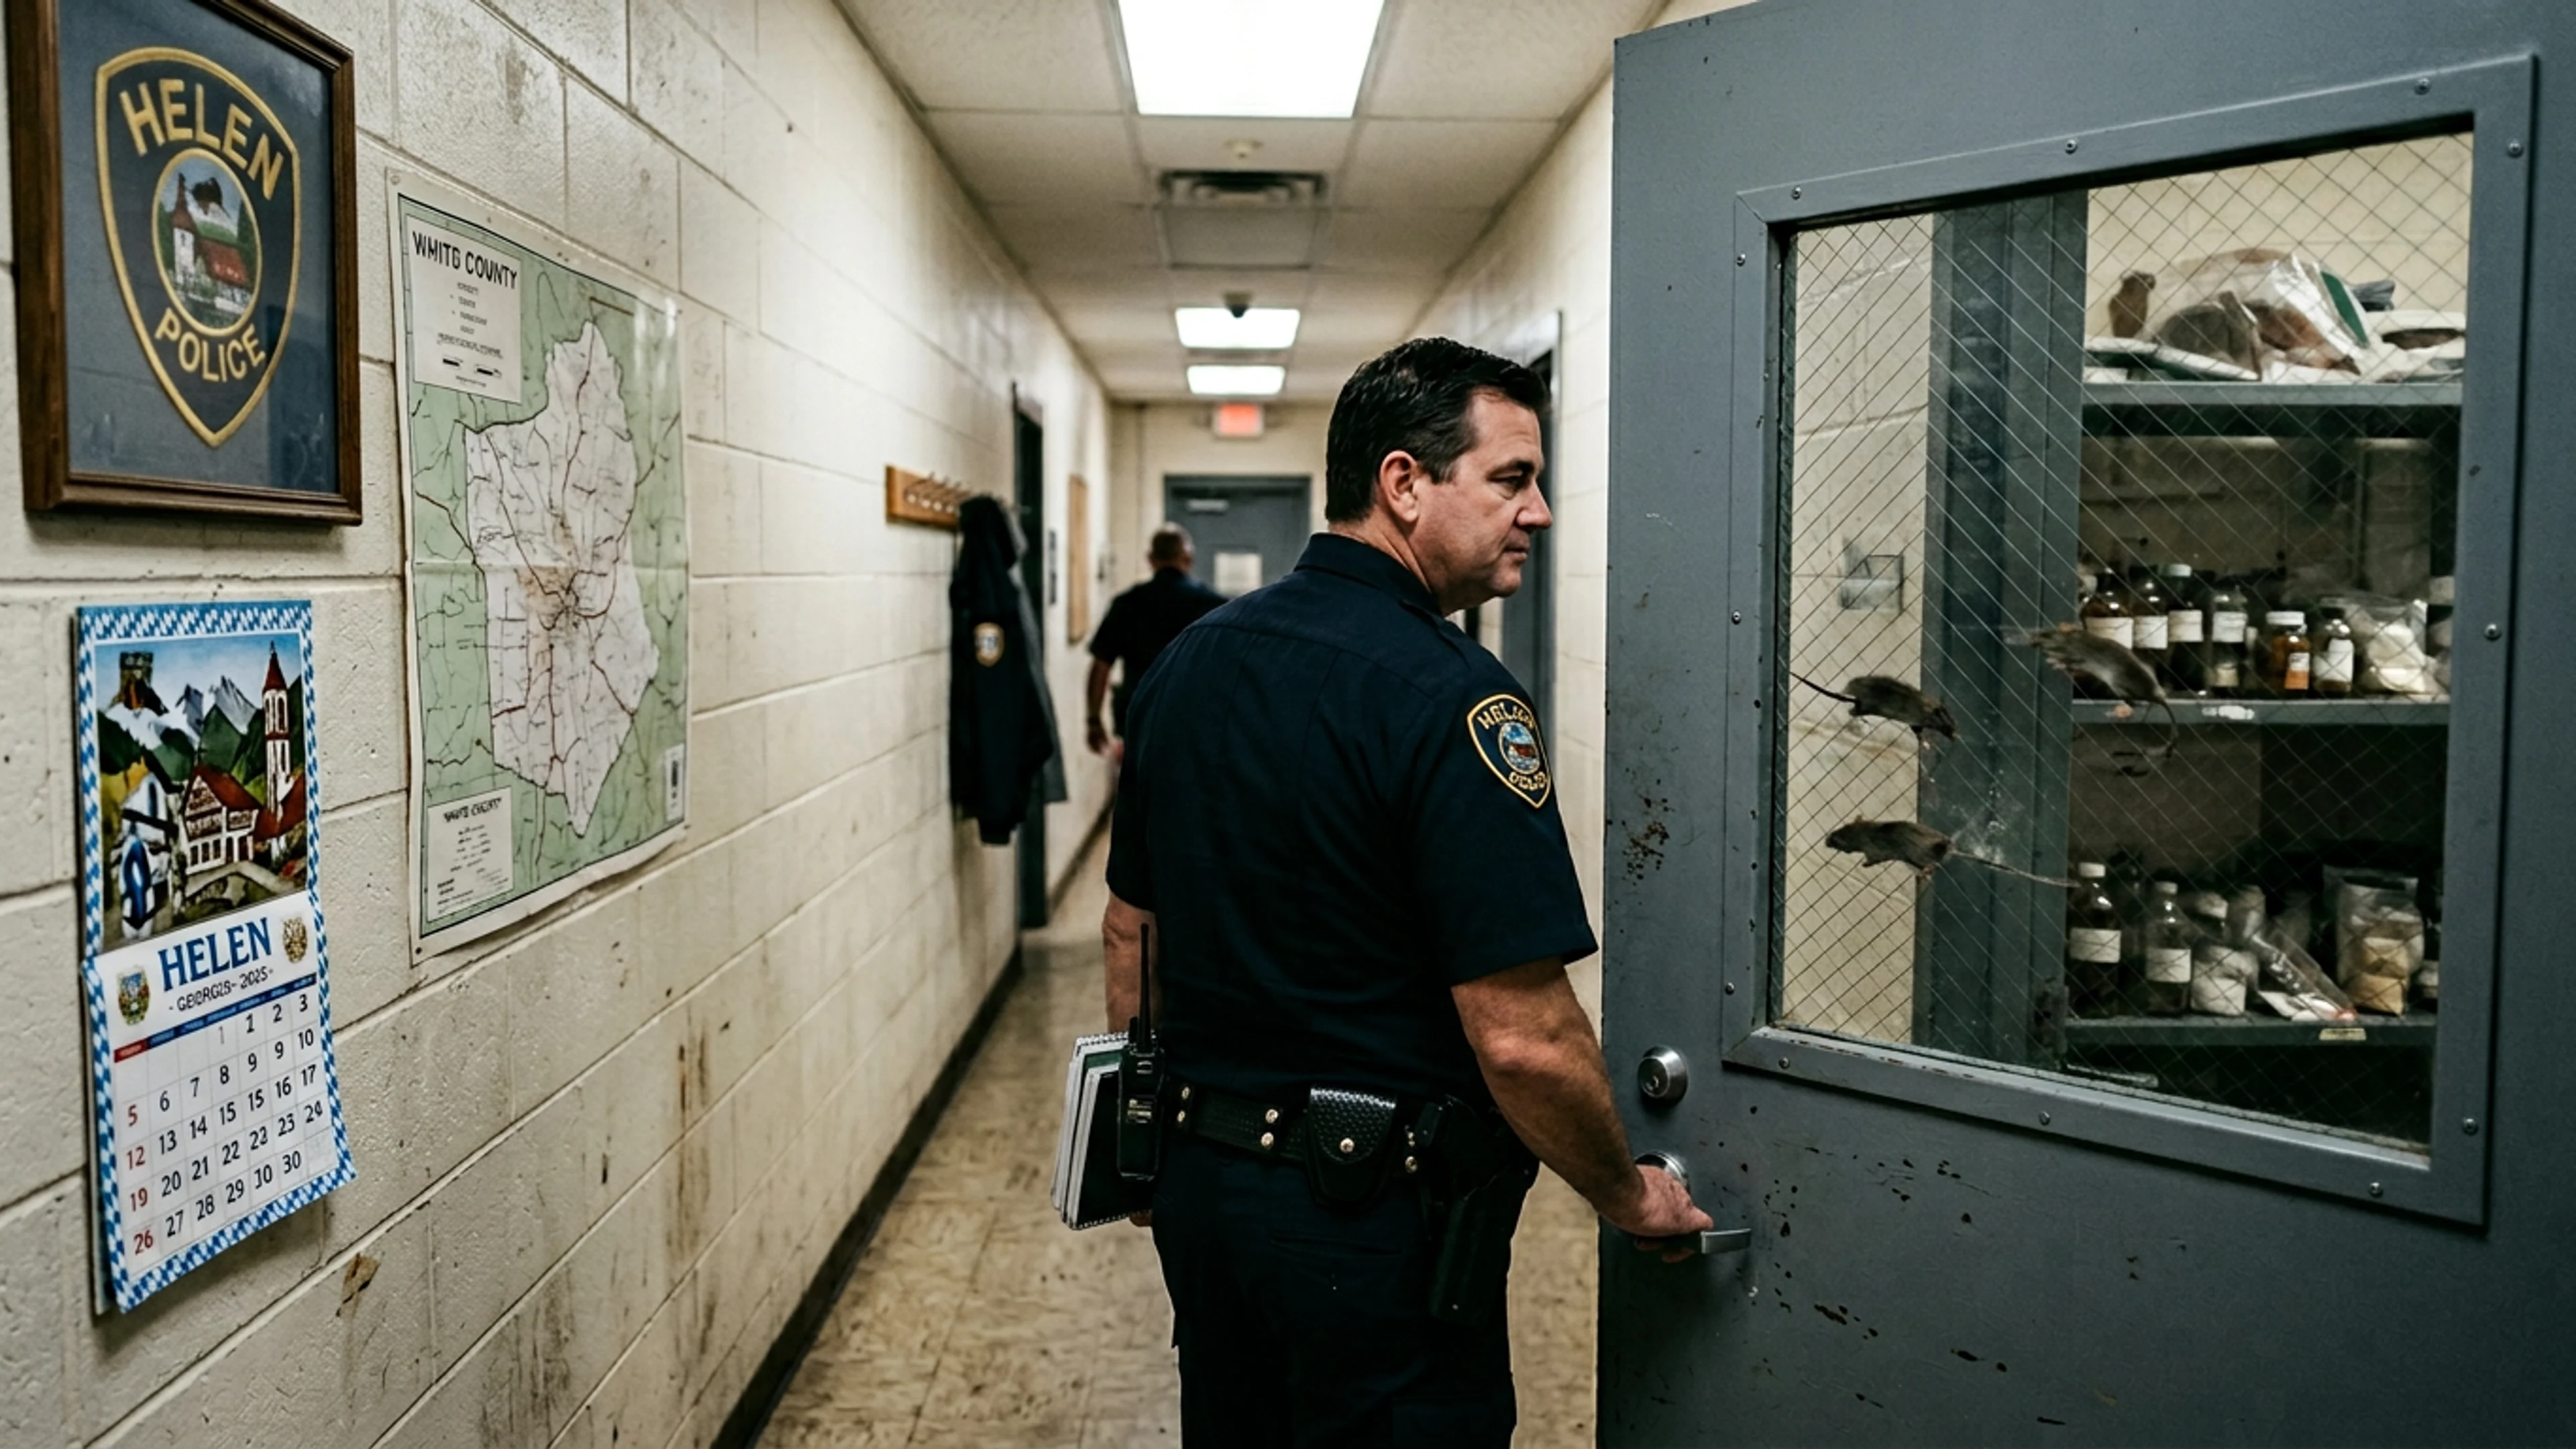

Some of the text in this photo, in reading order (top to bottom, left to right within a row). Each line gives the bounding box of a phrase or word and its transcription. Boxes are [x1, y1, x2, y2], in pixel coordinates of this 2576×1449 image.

[119, 78, 283, 200] HELEN
[465, 250, 517, 289] COUNTY
[155, 307, 267, 383] POLICE
[158, 917, 272, 992] HELEN
[246, 1013, 256, 1033] 1
[272, 1004, 282, 1023] 2
[299, 994, 309, 1012] 3
[127, 1028, 314, 1127] 5 6 7 8 9 9 10
[127, 1063, 317, 1170] 12 13 14 15 15 16 17
[130, 1187, 148, 1212] 19
[162, 1170, 182, 1197] 20
[192, 1156, 209, 1181] 21
[222, 1140, 241, 1166] 22
[278, 1113, 295, 1136] 23
[133, 1229, 154, 1255] 26
[166, 1210, 184, 1238] 27
[196, 1193, 215, 1221] 28
[226, 1179, 245, 1205] 29
[282, 1150, 302, 1174] 30
